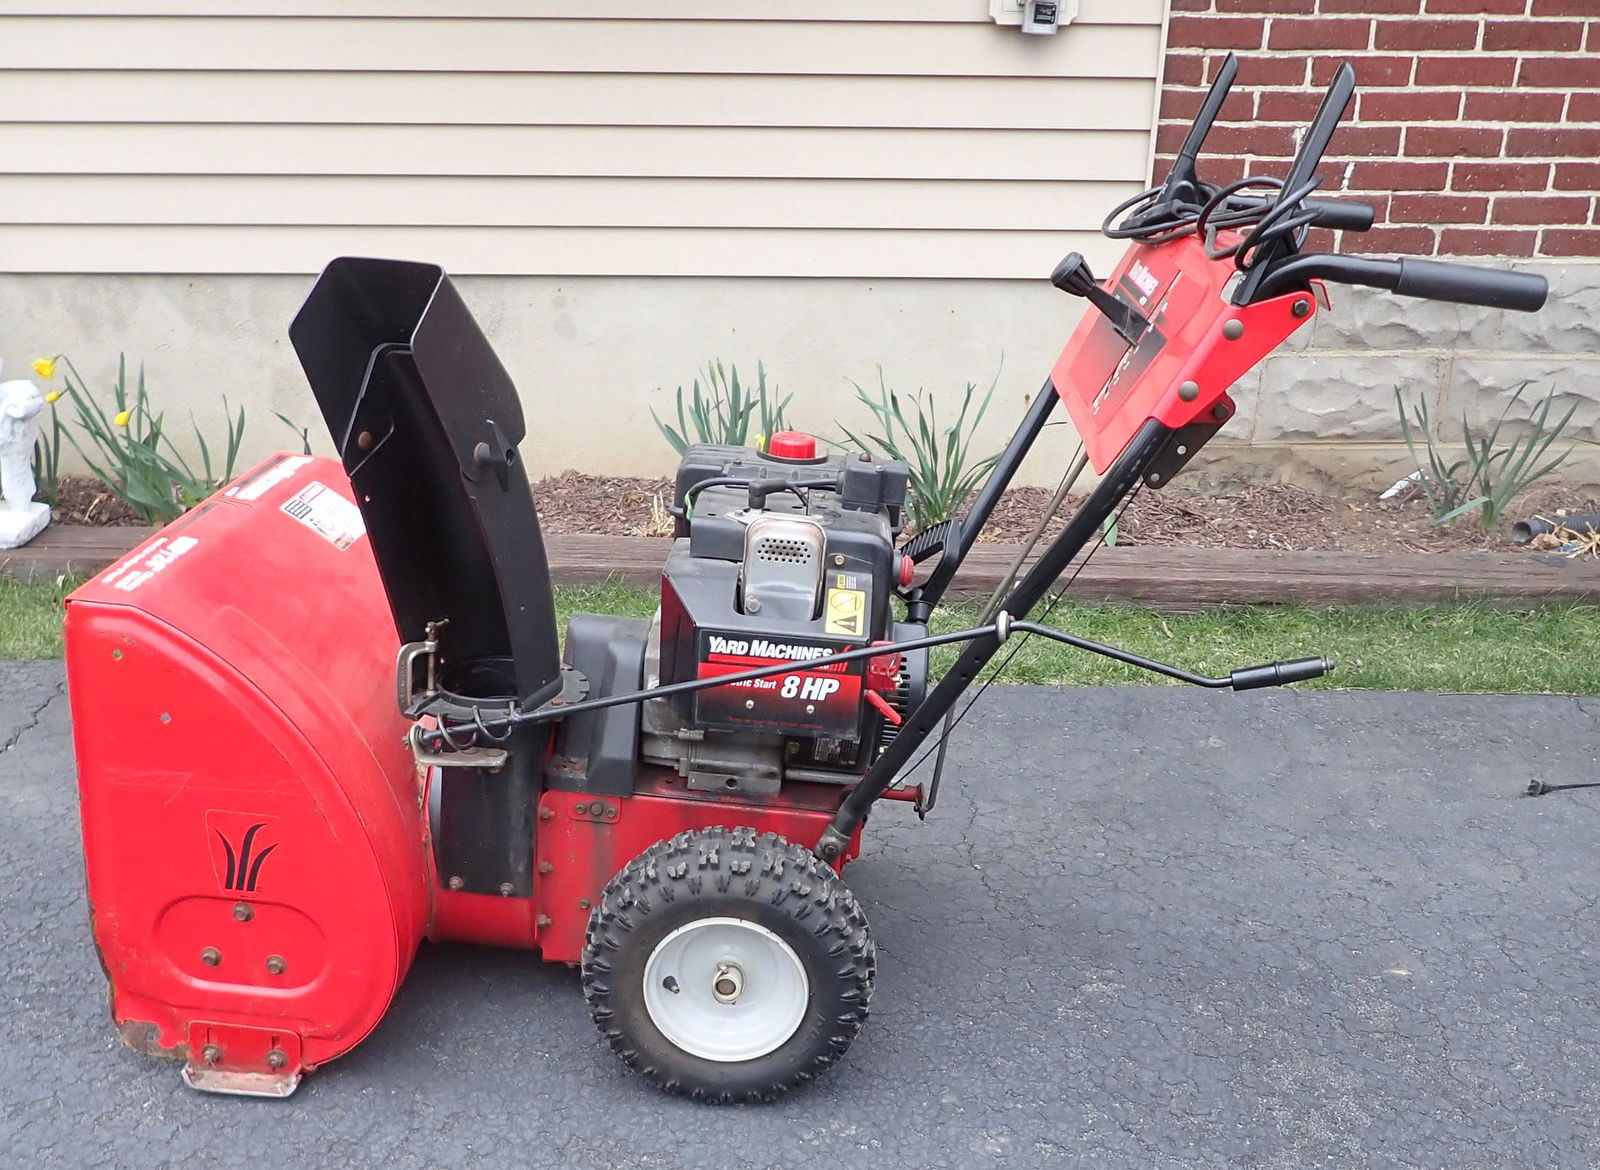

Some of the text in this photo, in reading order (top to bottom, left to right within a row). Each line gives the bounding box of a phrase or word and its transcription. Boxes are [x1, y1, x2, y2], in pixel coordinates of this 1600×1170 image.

[708, 636, 833, 660] YARD MACHINES
[753, 678, 777, 689] Start
[781, 675, 840, 701] 8 HP
